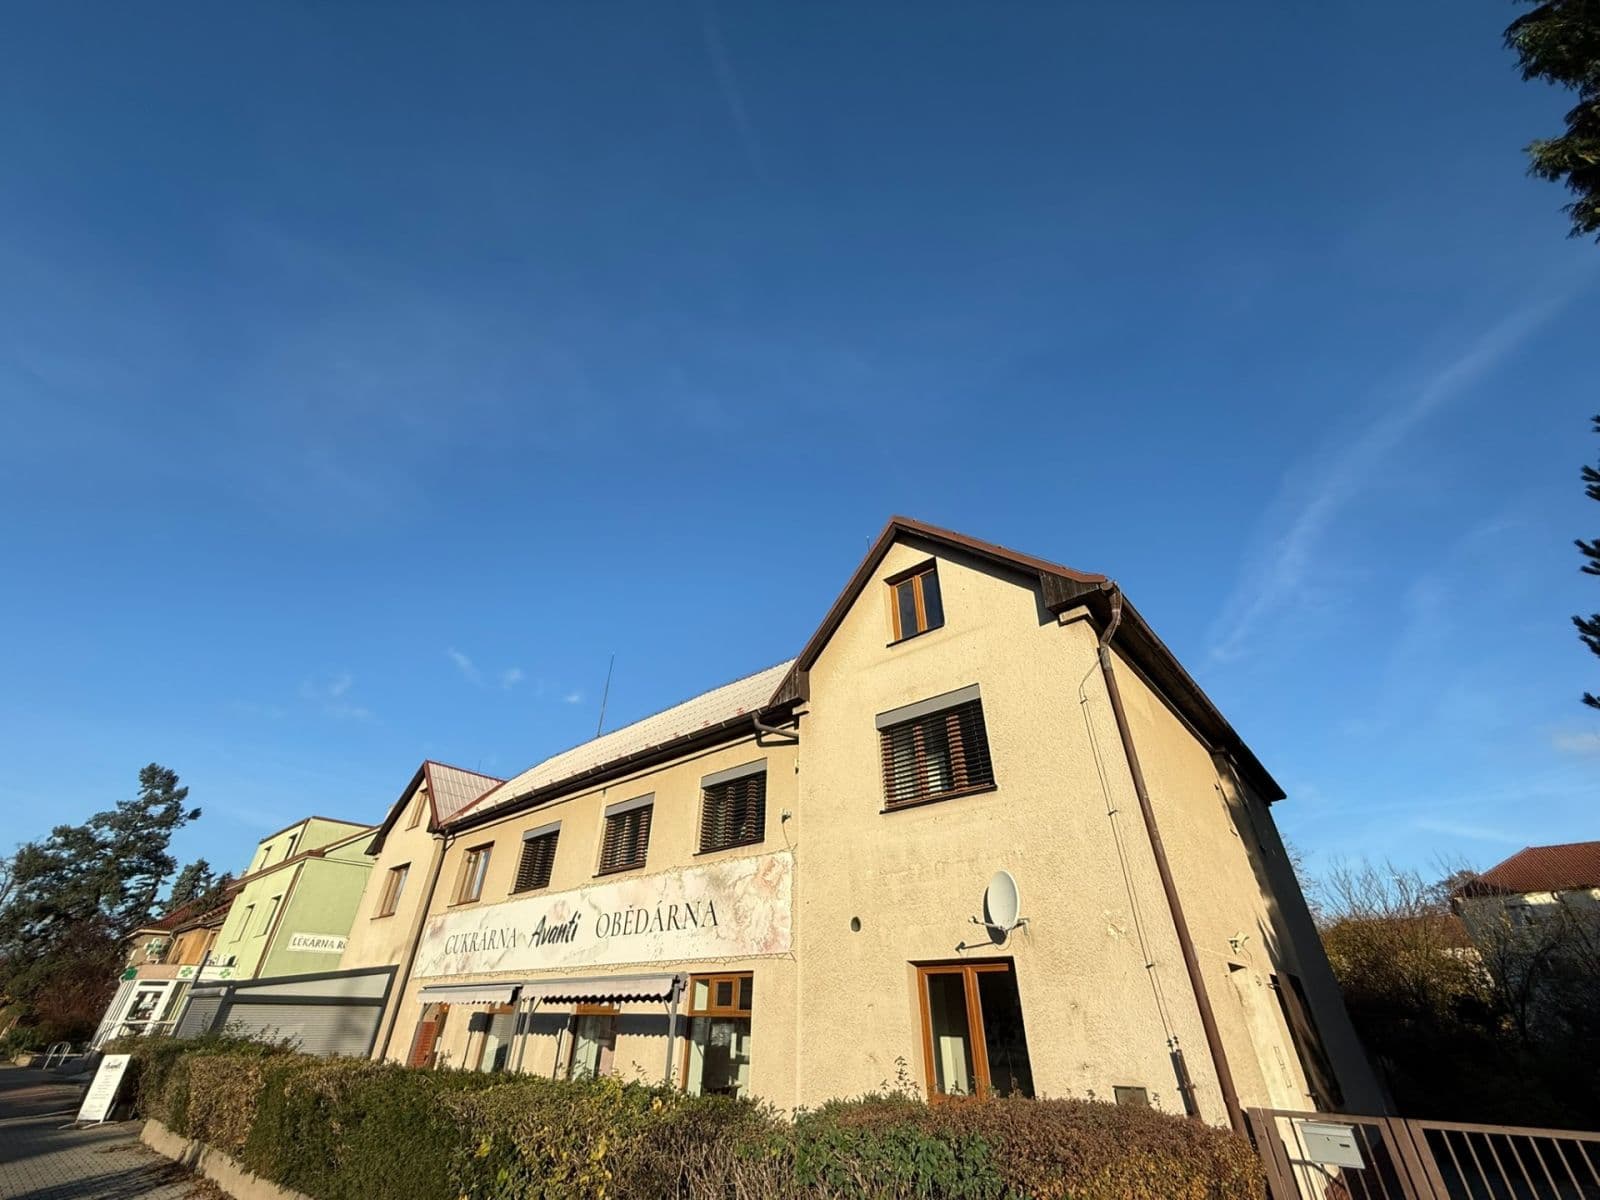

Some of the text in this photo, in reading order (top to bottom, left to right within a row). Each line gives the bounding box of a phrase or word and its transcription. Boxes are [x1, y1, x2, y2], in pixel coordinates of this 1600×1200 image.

[445, 899, 719, 955] CUKRÁRNA Avanti OBĚDÁRNA
